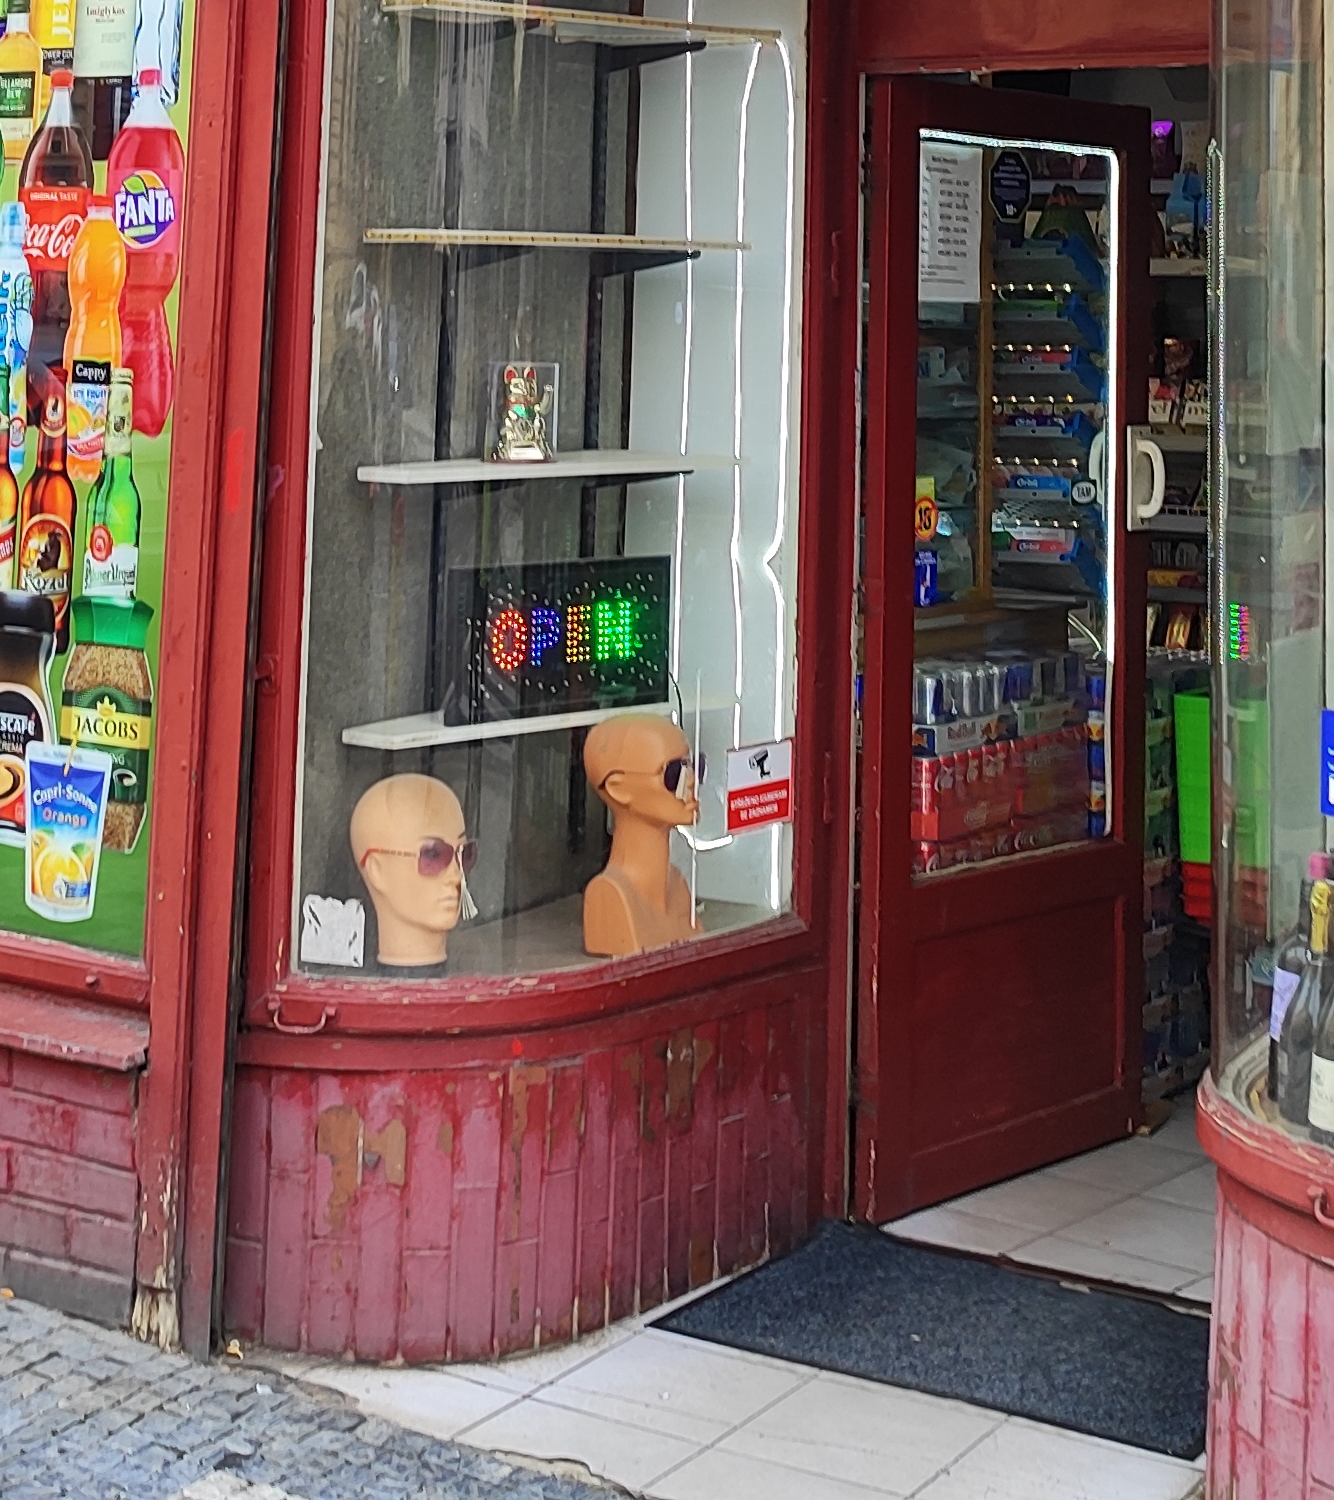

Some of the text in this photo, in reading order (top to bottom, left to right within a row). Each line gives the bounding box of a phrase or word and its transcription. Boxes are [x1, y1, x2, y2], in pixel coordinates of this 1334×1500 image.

[115, 189, 175, 229] FANTA
[75, 363, 107, 382] Cappy
[491, 600, 634, 671] OPEN
[74, 714, 139, 741] JACOBS
[41, 806, 88, 830] Orange
